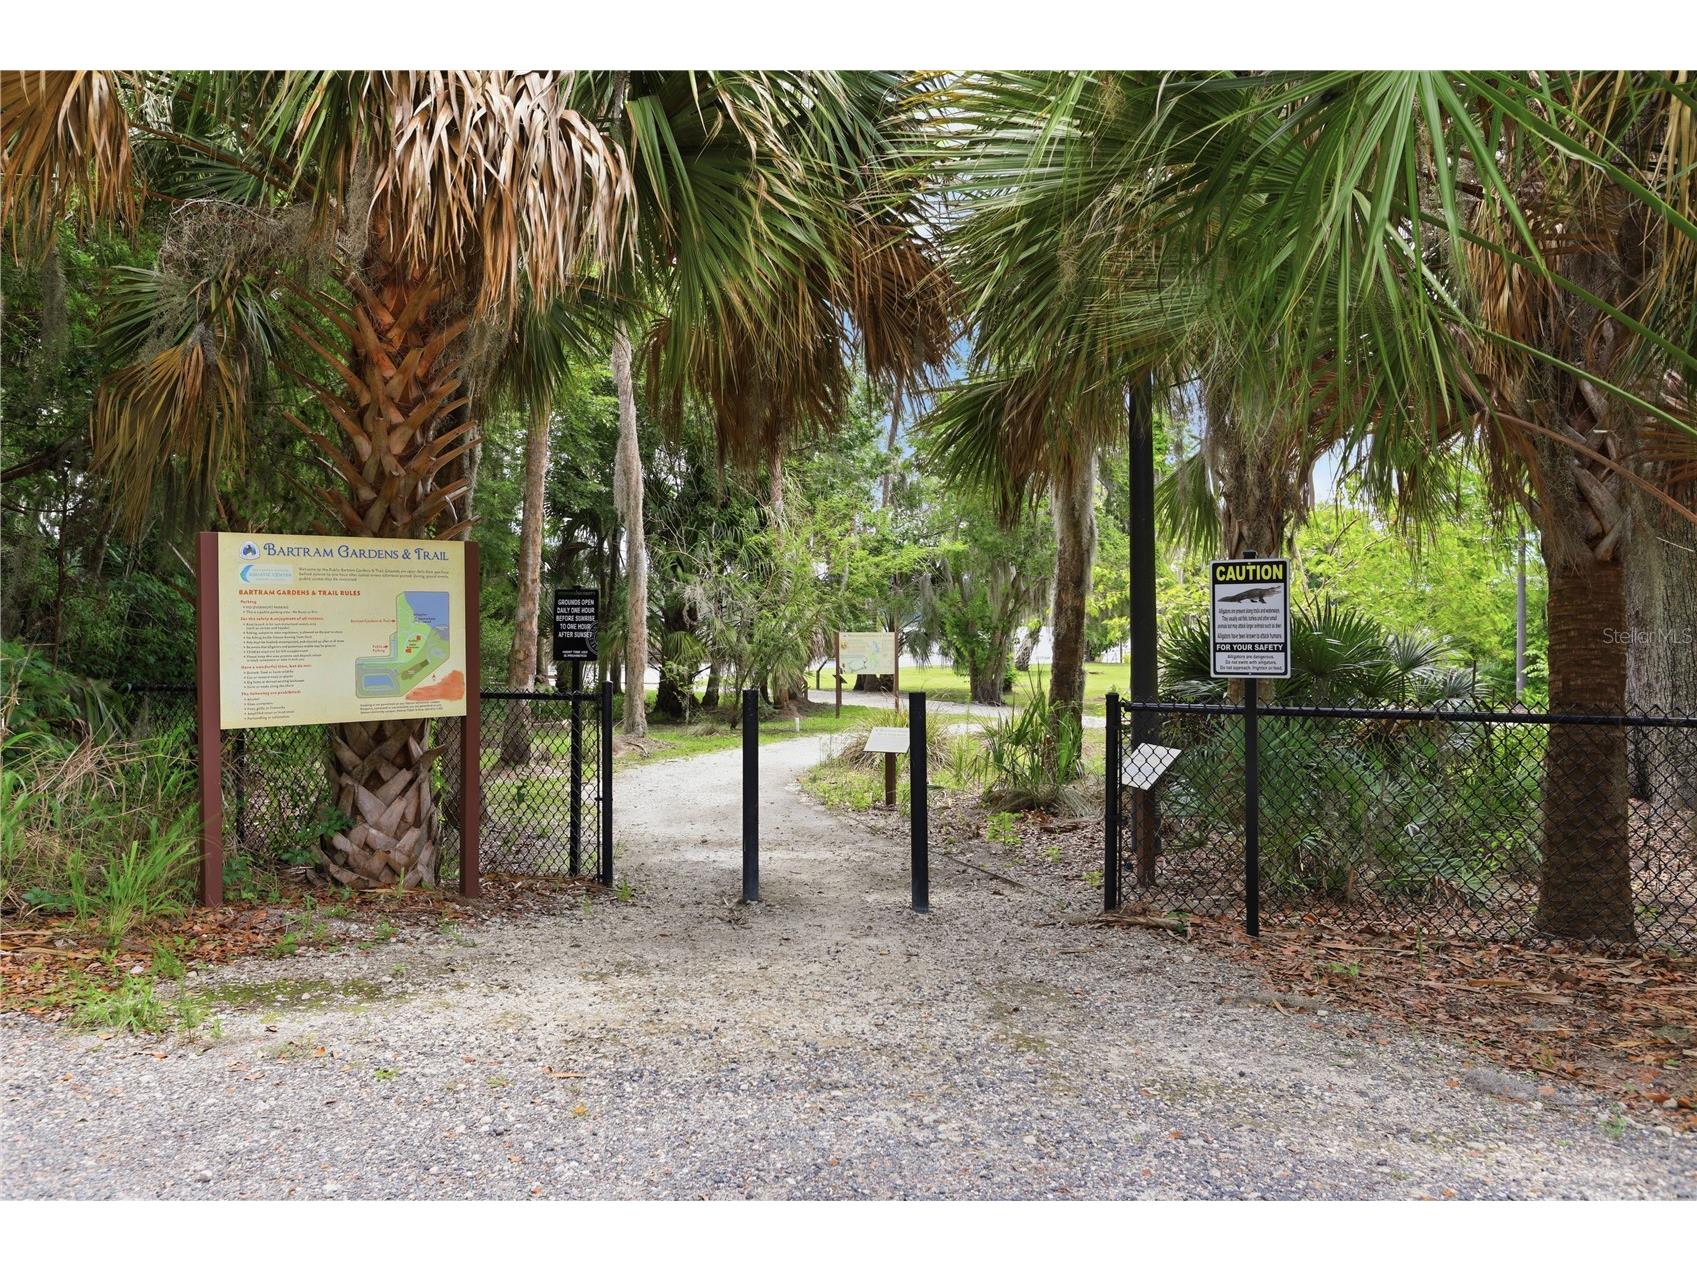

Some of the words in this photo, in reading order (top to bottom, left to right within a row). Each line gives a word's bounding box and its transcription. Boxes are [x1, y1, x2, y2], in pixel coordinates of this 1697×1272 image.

[263, 542, 334, 558] BARTRAM
[338, 545, 399, 559] GARDENS
[402, 549, 411, 560] &
[414, 548, 448, 560] TRAIL
[1216, 564, 1283, 581] CAUTION
